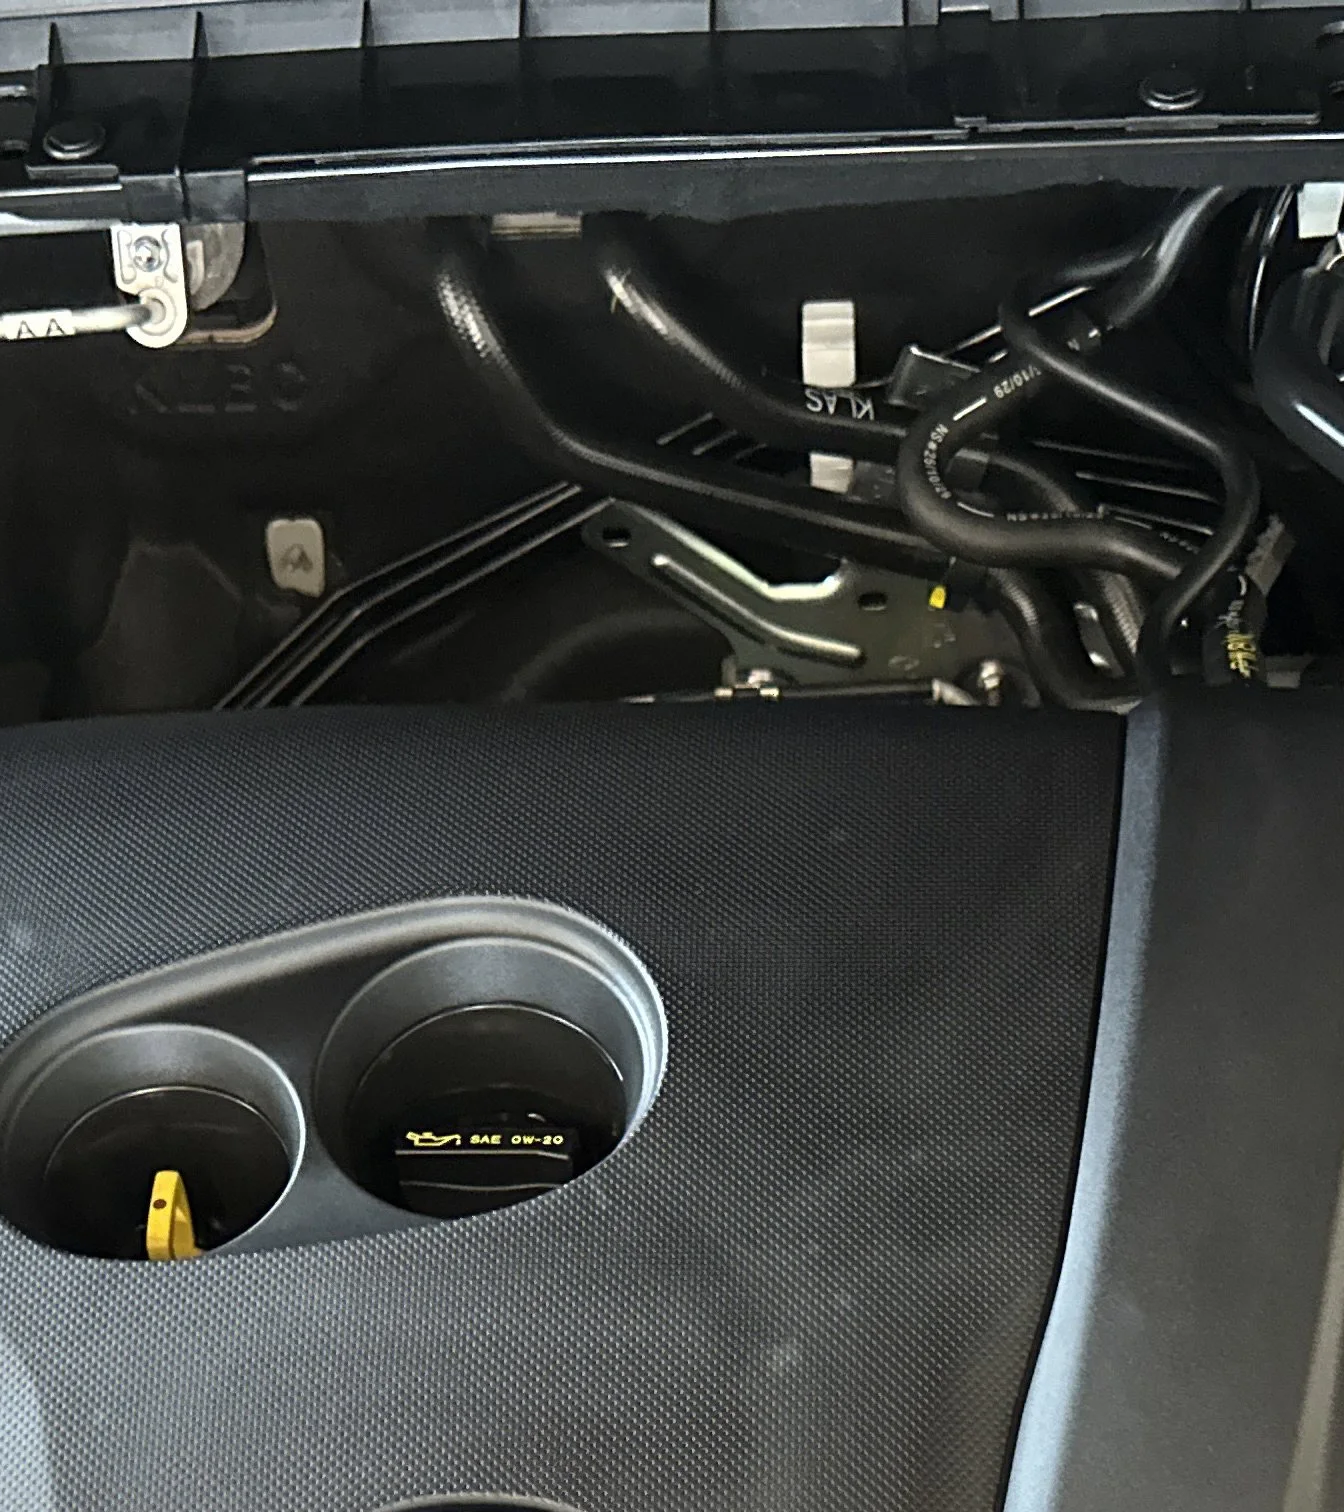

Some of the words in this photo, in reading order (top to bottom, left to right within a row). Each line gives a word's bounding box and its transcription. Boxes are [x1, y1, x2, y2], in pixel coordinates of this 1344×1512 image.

[805, 388, 875, 421] KLAS
[469, 1135, 502, 1144] SAE
[511, 1135, 564, 1145] 0W-20
